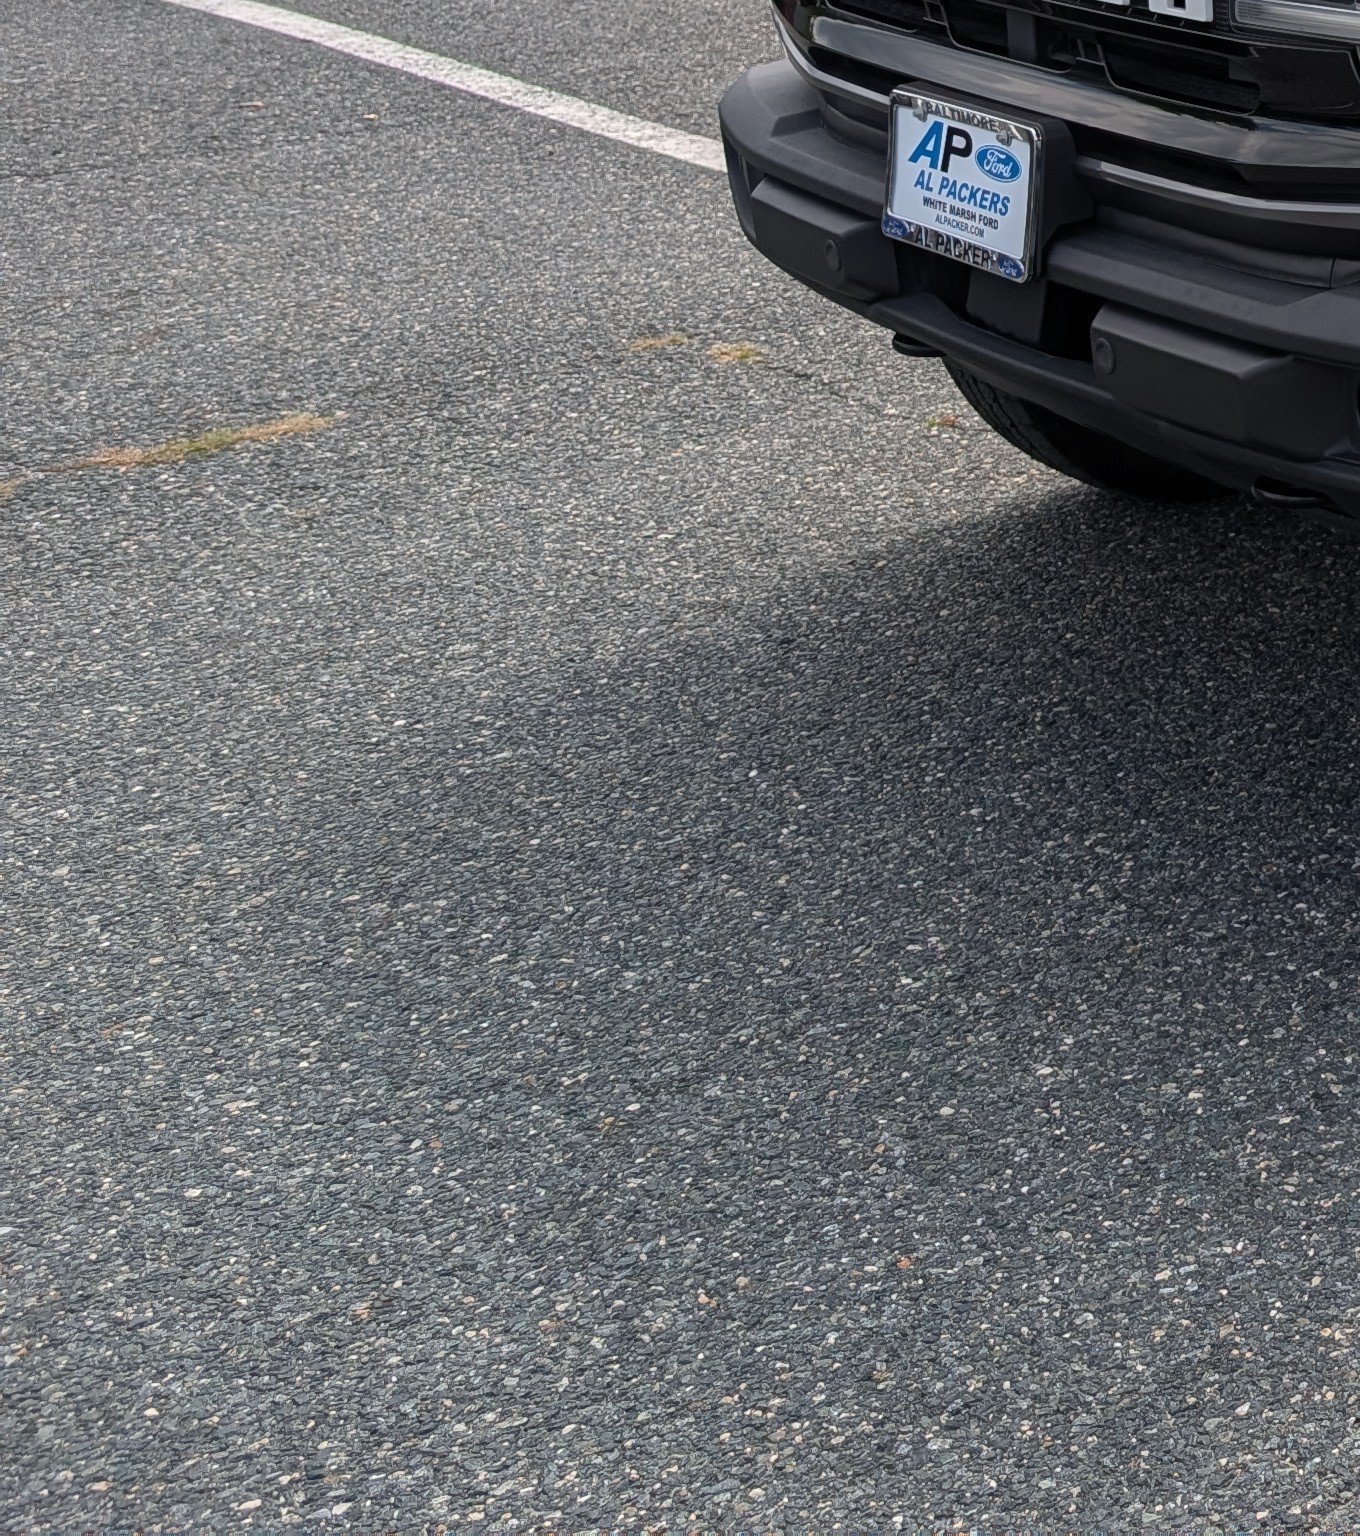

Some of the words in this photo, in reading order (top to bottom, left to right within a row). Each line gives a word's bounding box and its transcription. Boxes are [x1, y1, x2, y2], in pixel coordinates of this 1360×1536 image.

[924, 101, 1000, 133] BALTIMORE
[907, 120, 974, 174] AP
[983, 149, 1014, 178] Ford
[914, 169, 934, 194] AL
[937, 176, 1012, 217] PACKERS
[922, 195, 948, 214] WHITE
[949, 204, 977, 224] MARSH
[978, 214, 999, 231] FORD
[934, 213, 985, 239] ALPACKER.COM
[914, 225, 933, 249] AL
[936, 232, 993, 270] PACKER
